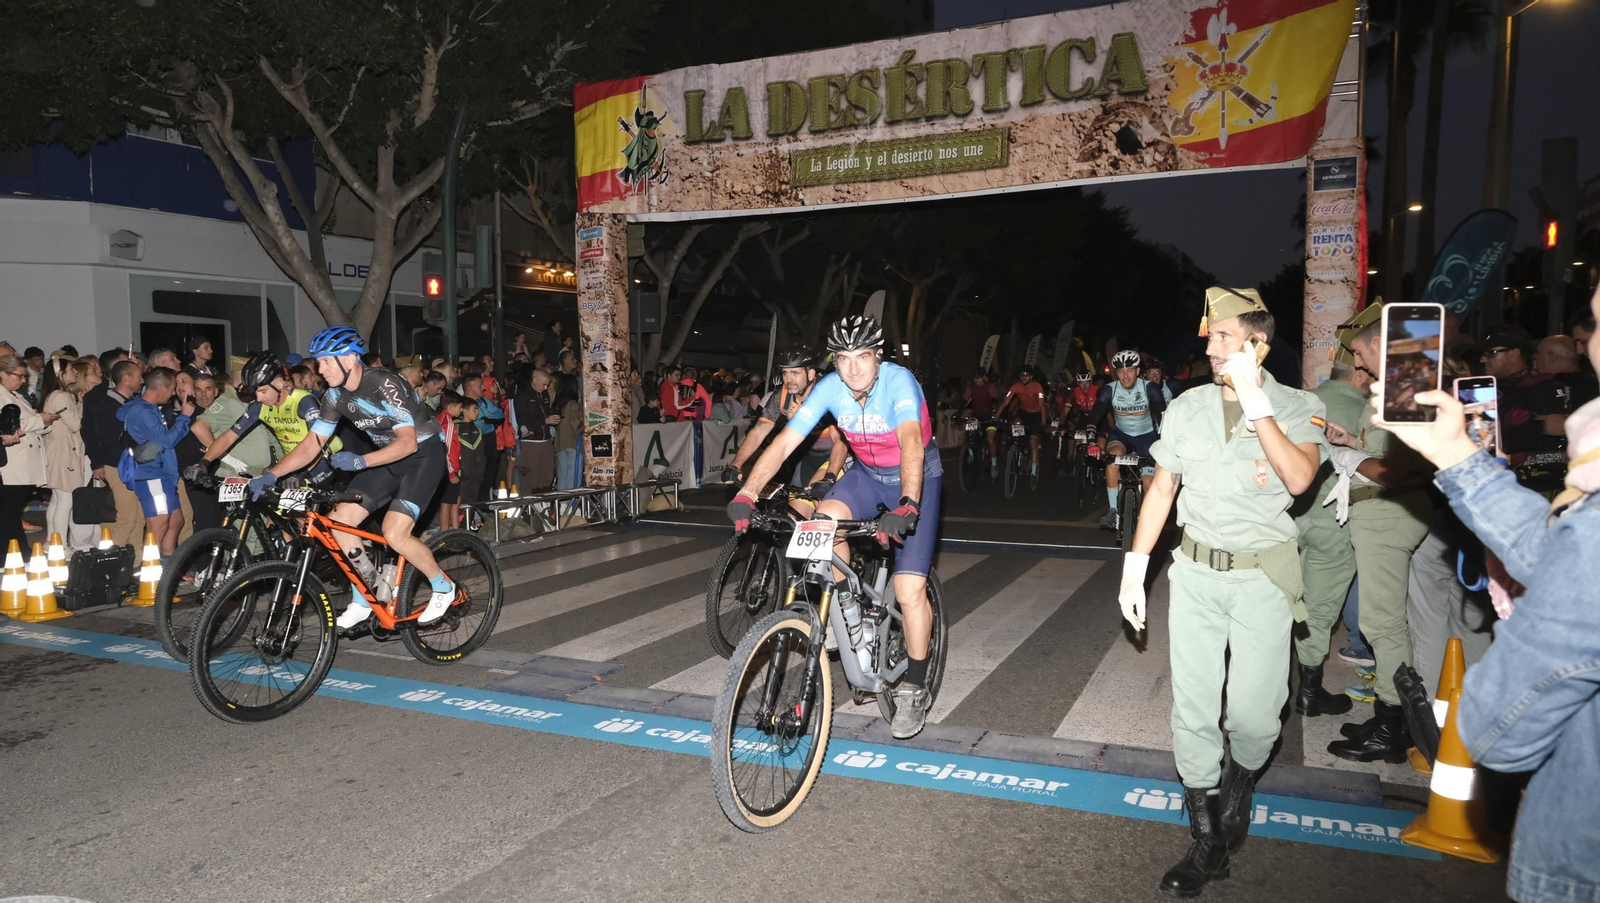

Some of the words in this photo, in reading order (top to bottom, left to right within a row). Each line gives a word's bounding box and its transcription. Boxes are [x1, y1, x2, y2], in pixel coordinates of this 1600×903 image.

[683, 86, 753, 144] LA
[766, 31, 1149, 137] DESÉRTICA
[810, 158, 822, 173] La
[826, 154, 860, 172] Legión
[865, 156, 873, 170] y
[877, 151, 887, 166] el
[891, 148, 933, 165] desierto
[939, 147, 958, 160] nos
[963, 144, 984, 157] une
[1313, 226, 1353, 234] GRUPO
[1313, 233, 1354, 245] RENTA
[582, 301, 601, 311] BBVA
[354, 418, 377, 429] OWER
[708, 465, 725, 473] Junta
[223, 484, 244, 495] 7365
[796, 531, 832, 549] 6987
[319, 593, 334, 627] MAXXIS
[436, 651, 462, 661] MAXXIS
[442, 697, 563, 720] cajamar
[895, 761, 1070, 793] cajamar
[972, 780, 1007, 791] CAJA
[1011, 786, 1058, 798] RURAL
[1300, 825, 1345, 838] CAJA
